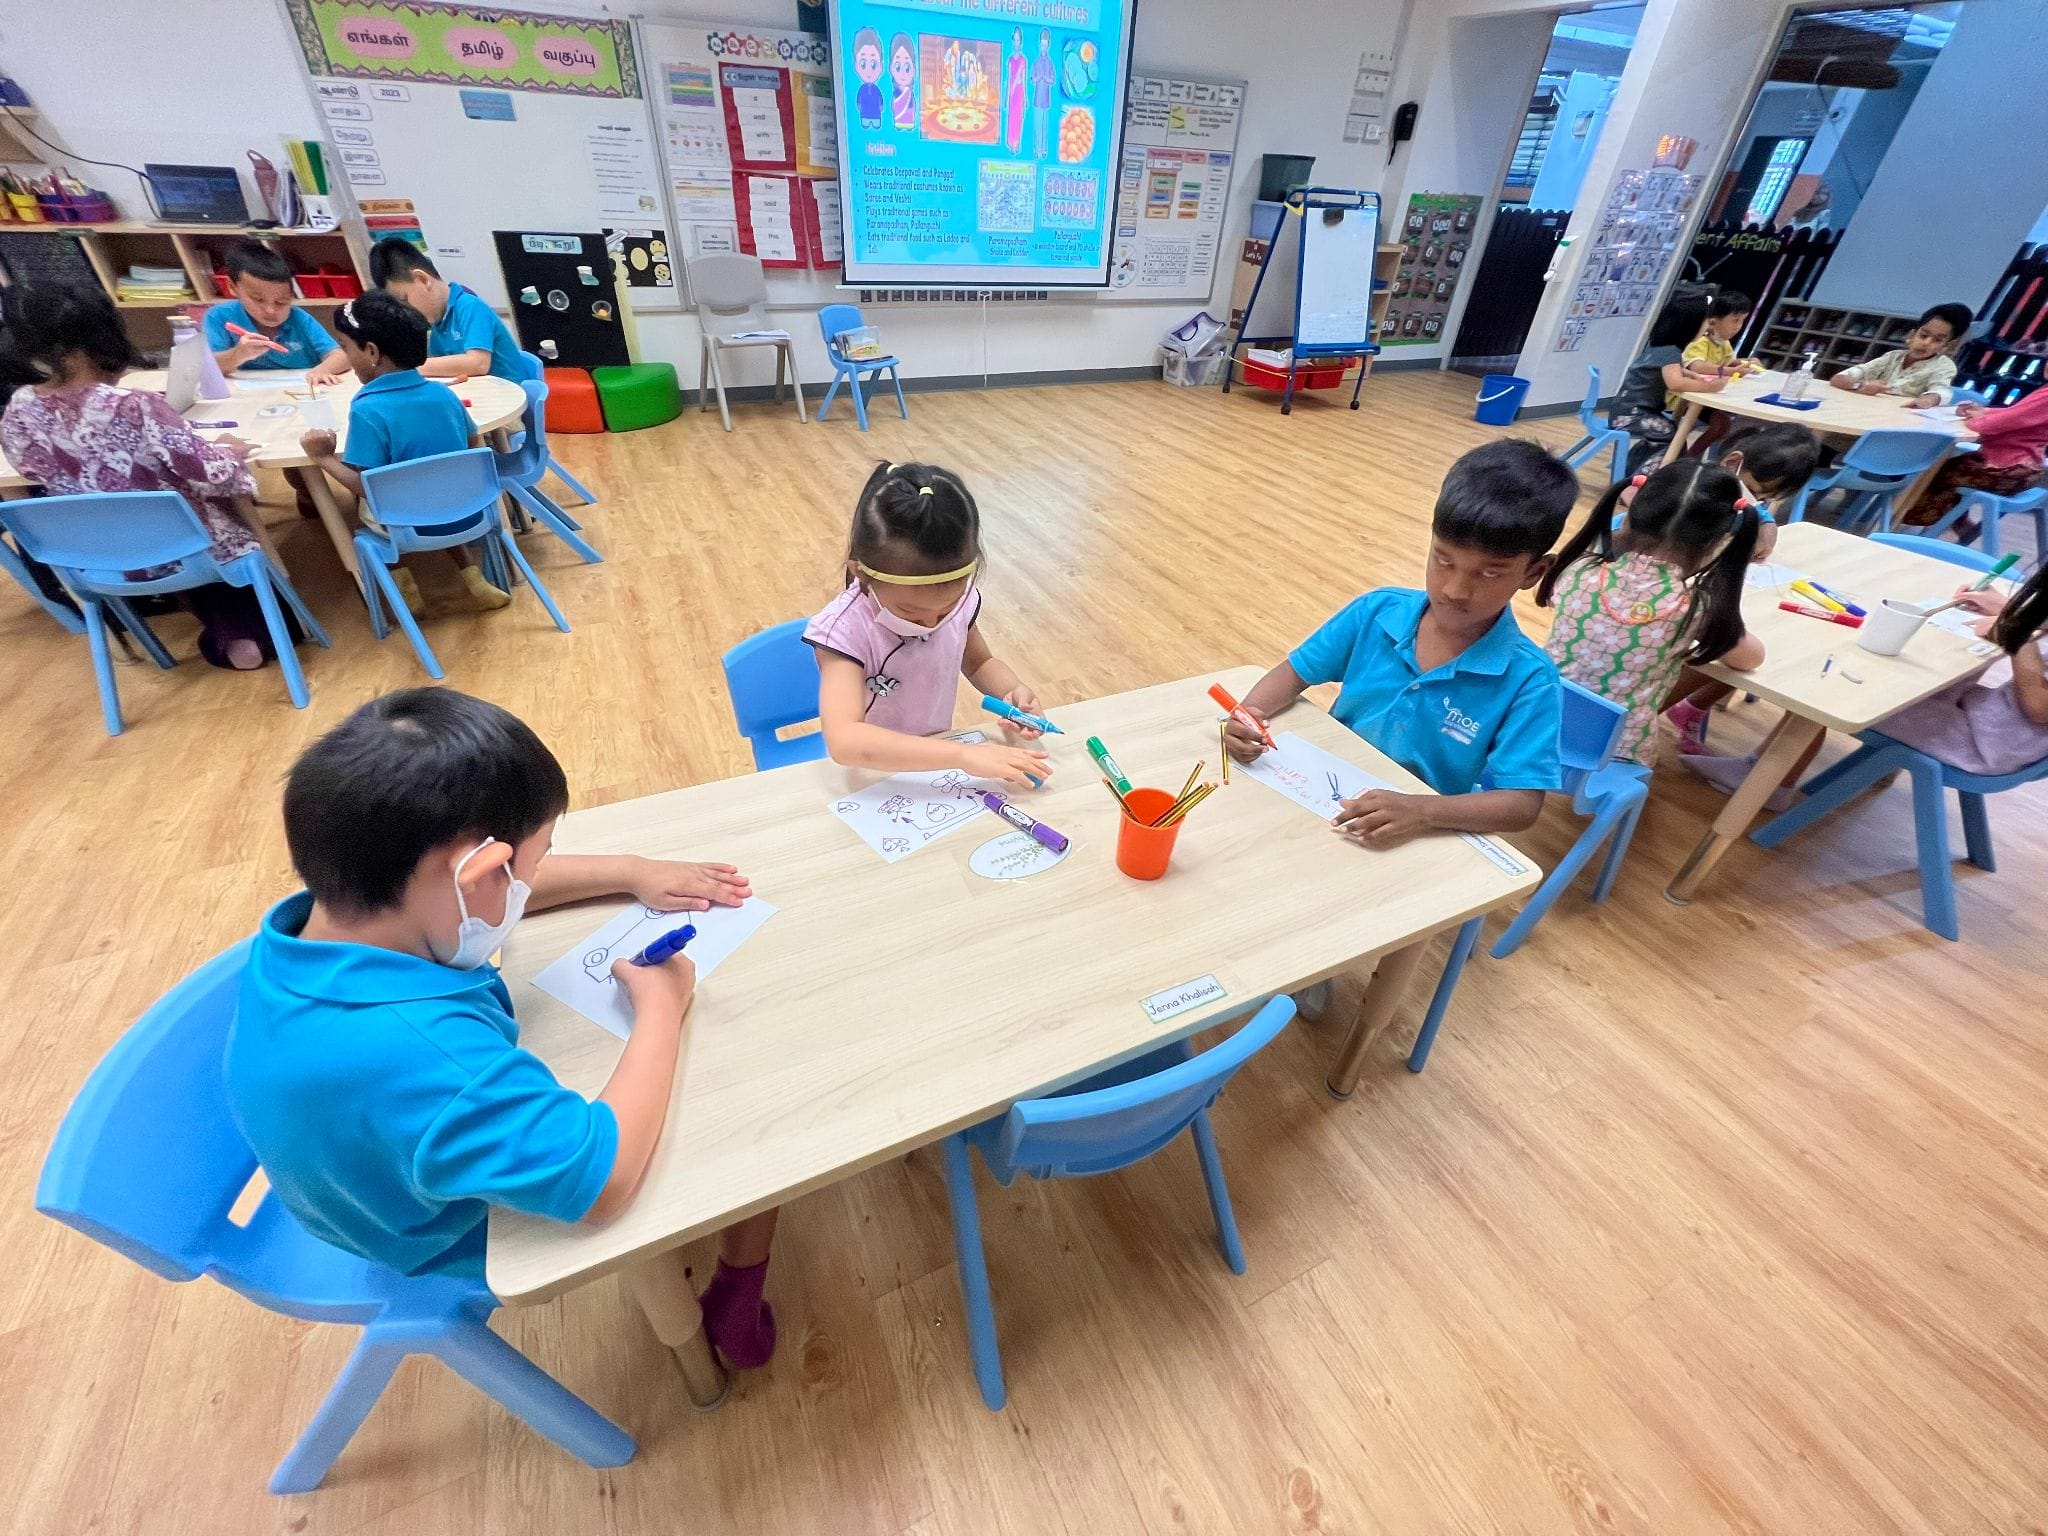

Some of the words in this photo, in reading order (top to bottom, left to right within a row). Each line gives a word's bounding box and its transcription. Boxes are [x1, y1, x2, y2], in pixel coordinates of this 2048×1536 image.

[983, 0, 1039, 17] different
[1042, 2, 1088, 24] cultures
[347, 28, 409, 47] எங்கள்
[461, 40, 504, 60] தமிழ்
[543, 49, 596, 68] வகுப்பு
[863, 165, 894, 177] Celebrates
[895, 167, 921, 180] Deepavali
[922, 168, 933, 178] and
[864, 179, 883, 190] Wears
[883, 180, 912, 191] traditional
[913, 182, 938, 192] costumes
[939, 183, 956, 192] known
[865, 193, 881, 202] Saree
[882, 194, 894, 203] and
[866, 206, 881, 218] Plays
[882, 206, 911, 217] traditional
[911, 209, 928, 219] games
[929, 207, 941, 217] such
[867, 232, 880, 241] Eats
[881, 231, 909, 242] traditional
[909, 232, 921, 242] food
[923, 233, 935, 242] such
[960, 234, 970, 243] and
[1695, 232, 1726, 247] ent
[1148, 1000, 1180, 1016] Jenna
